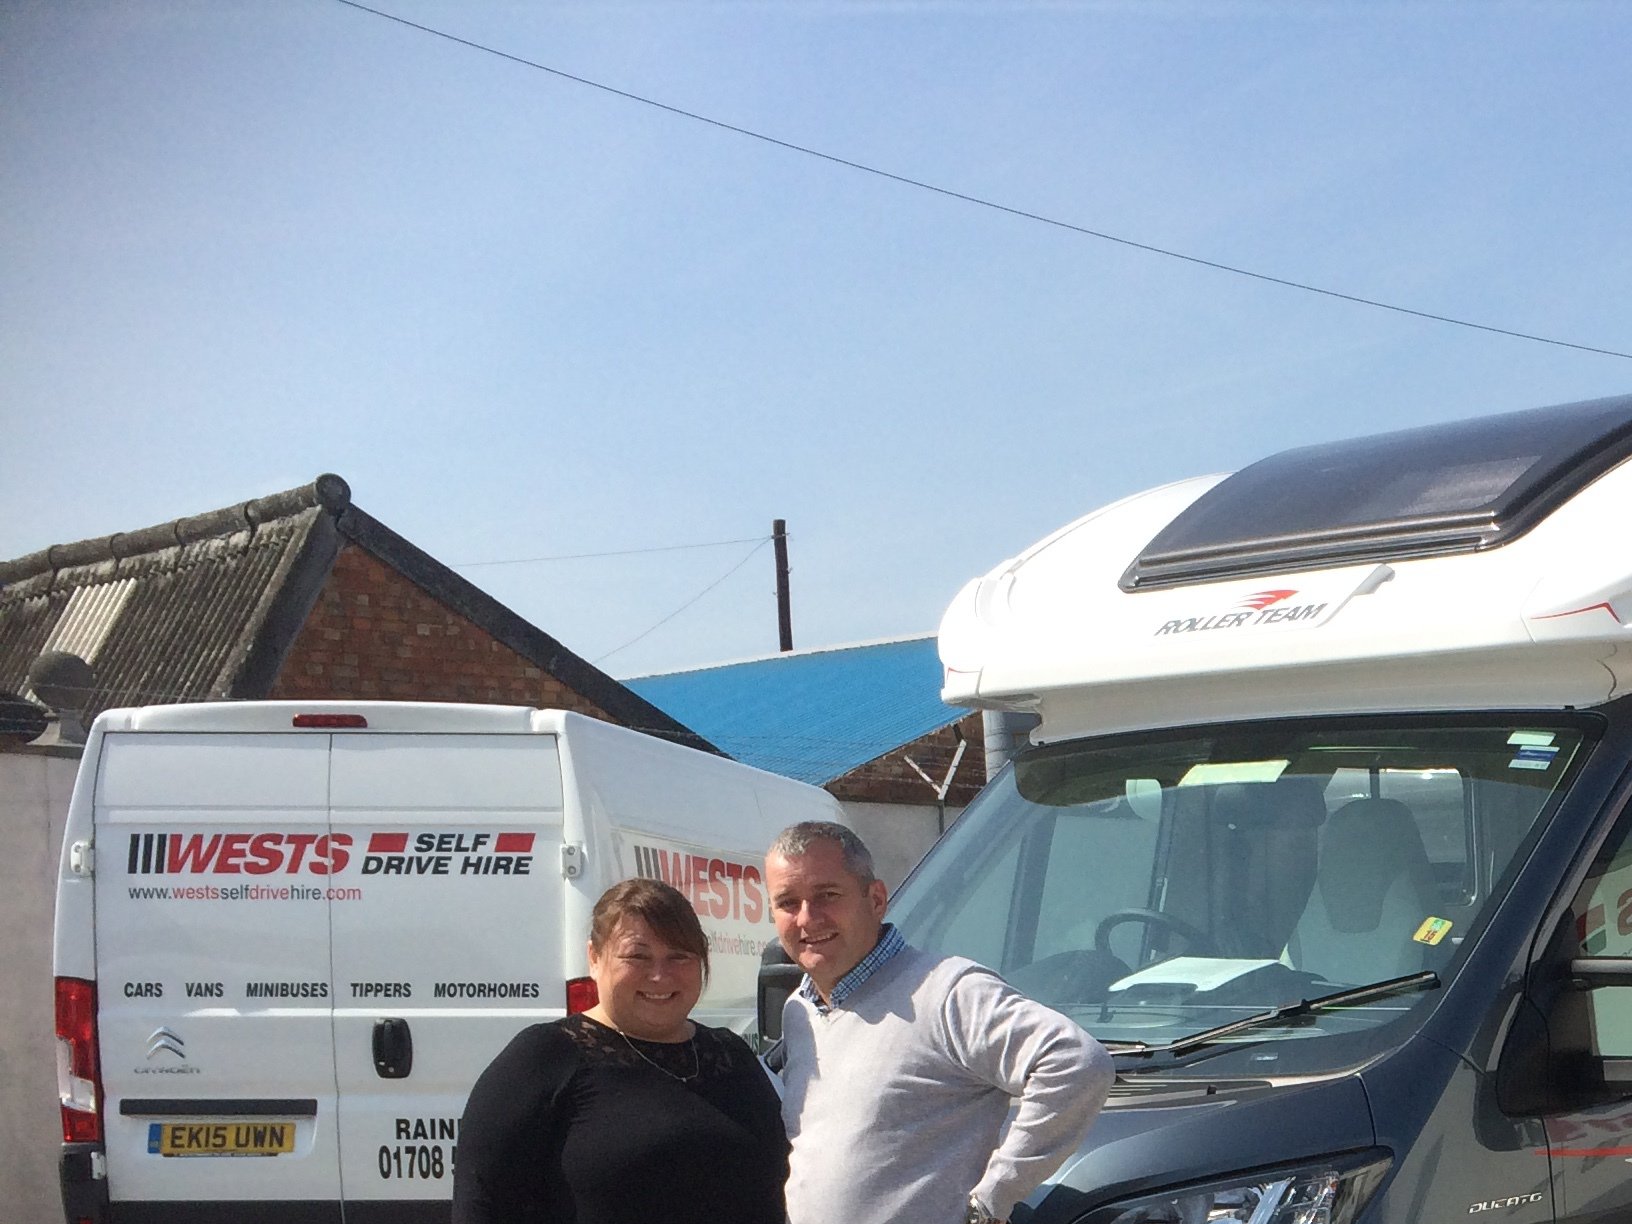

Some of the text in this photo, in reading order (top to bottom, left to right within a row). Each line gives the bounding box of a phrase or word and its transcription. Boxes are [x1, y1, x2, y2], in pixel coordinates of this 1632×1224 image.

[1154, 602, 1328, 636] ROLLER TEAM
[167, 833, 353, 875] WESTS
[414, 833, 490, 853] SELF
[361, 856, 533, 875] DRIVE HIRE
[128, 884, 362, 900] www.westsselfdrivehire.com
[124, 982, 540, 998] CARS VANS MINIBUSES TIPPERS MOTORHOMES
[170, 1126, 285, 1148] EK15 UWN
[396, 1118, 463, 1140] RAIN
[379, 1145, 444, 1179] 01708
